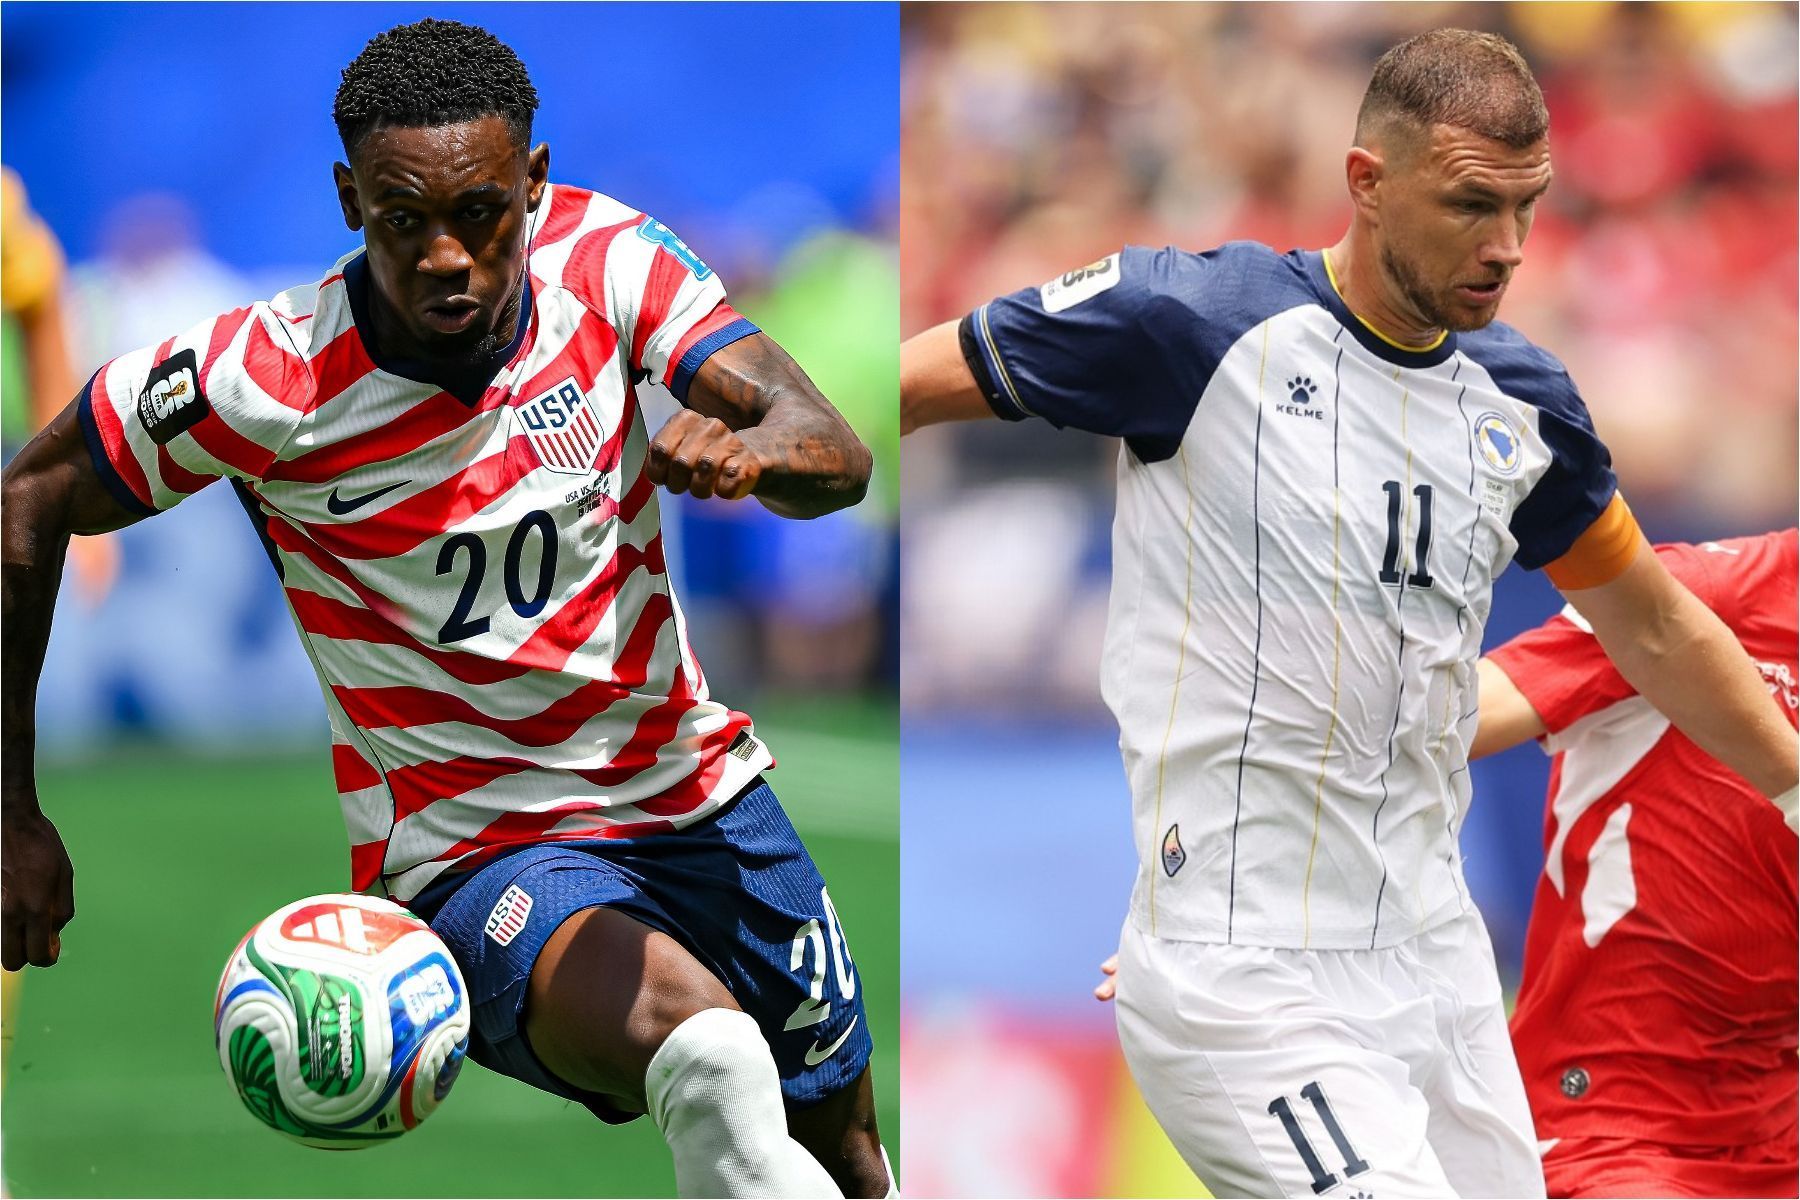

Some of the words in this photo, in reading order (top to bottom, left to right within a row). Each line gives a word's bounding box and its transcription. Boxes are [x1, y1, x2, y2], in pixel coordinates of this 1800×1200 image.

[140, 392, 154, 428] 2026
[154, 393, 163, 411] FIFA
[522, 383, 581, 430] USA
[1276, 404, 1323, 420] KELME
[565, 490, 579, 504] USA
[1378, 480, 1435, 590] 11
[436, 510, 558, 644] 20
[487, 889, 517, 933] USA
[783, 885, 855, 1032] 20
[1267, 1081, 1374, 1196] 11
